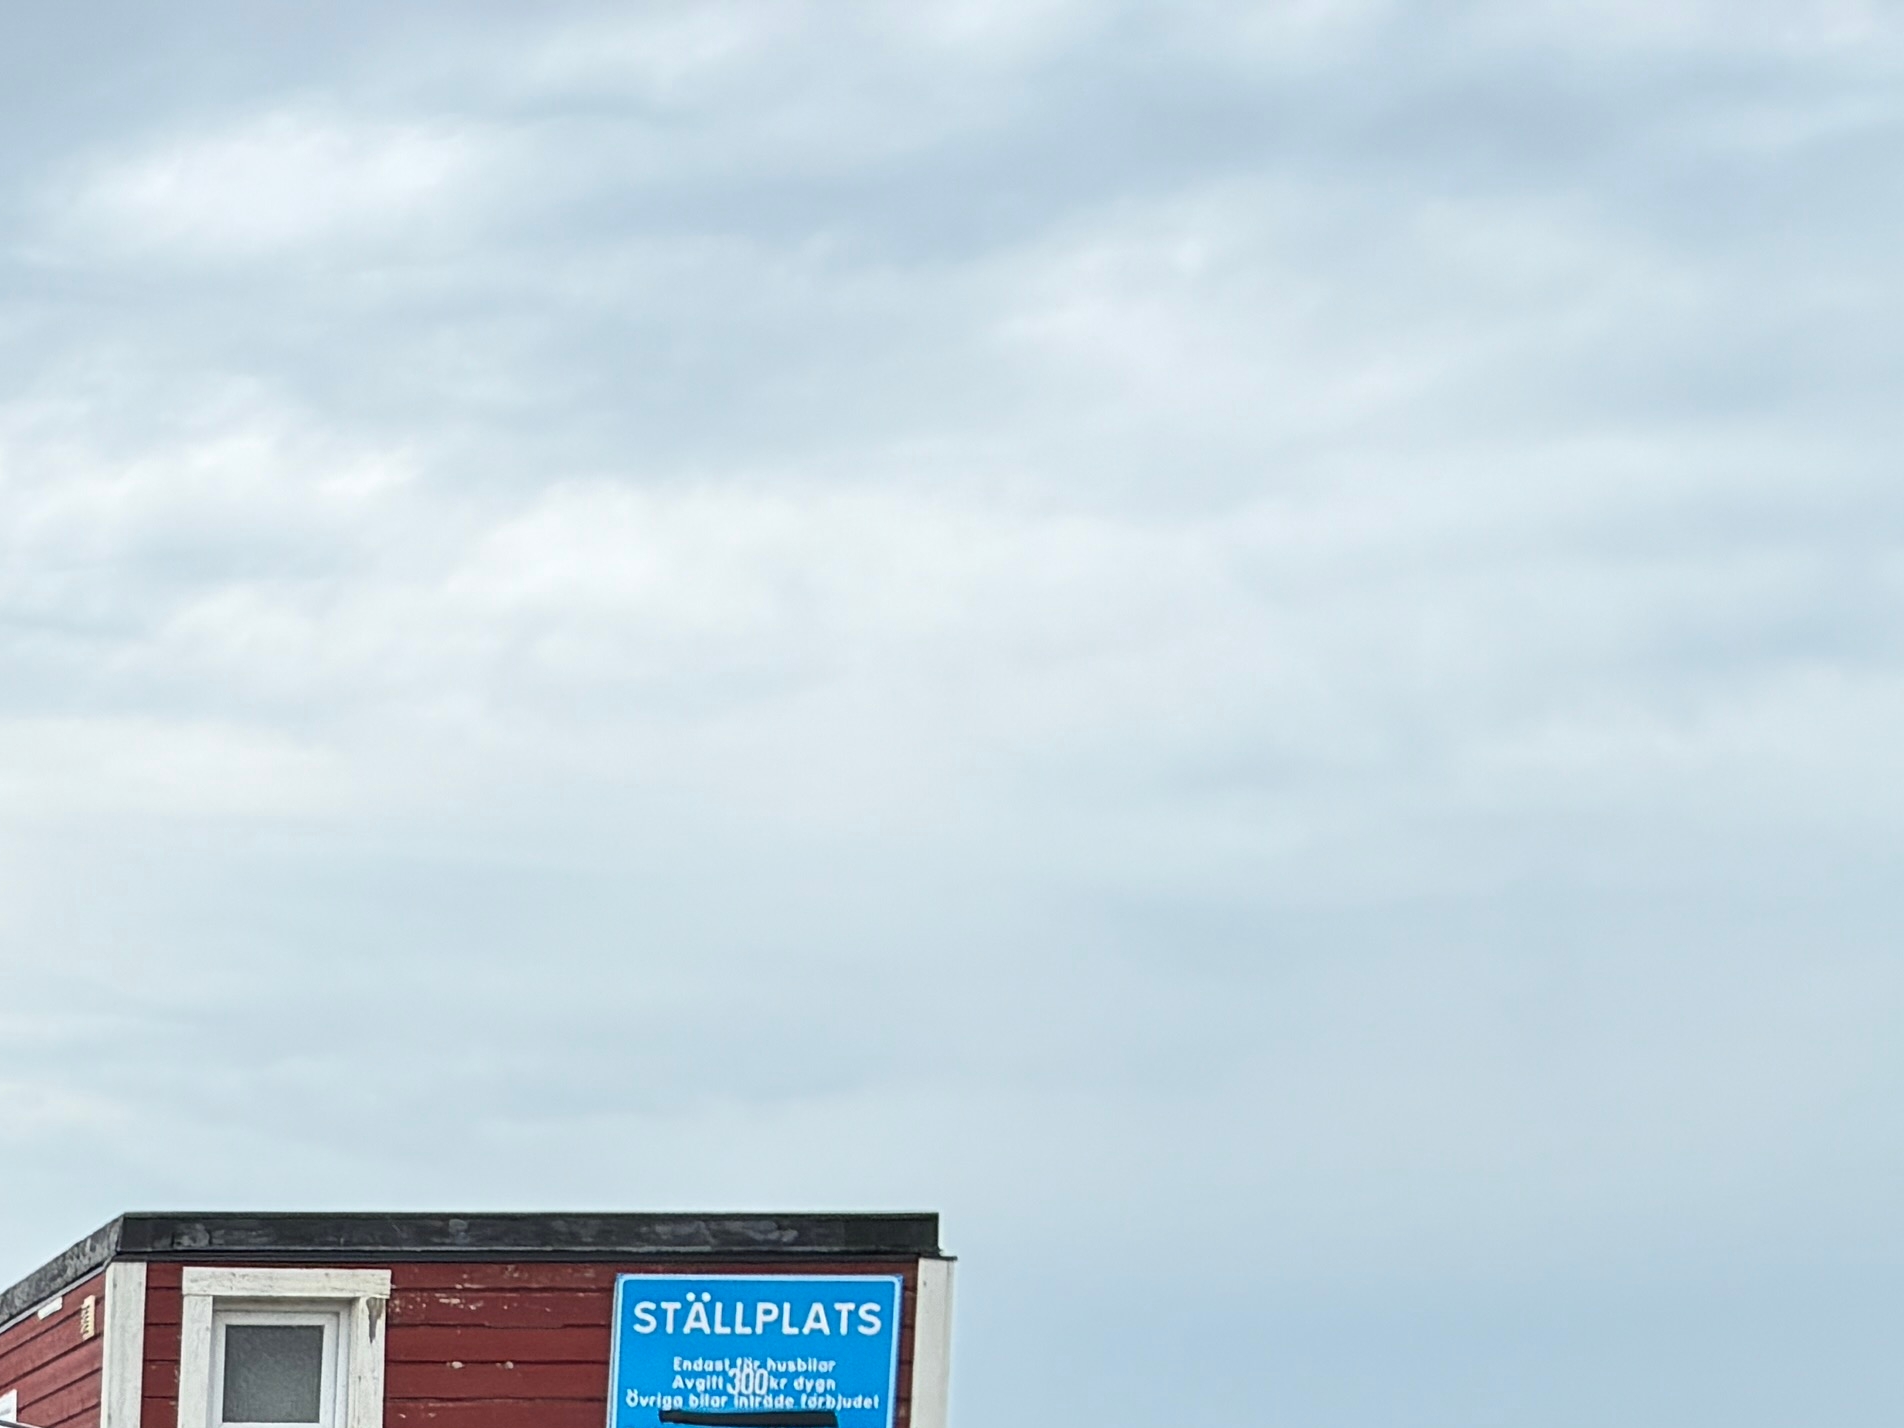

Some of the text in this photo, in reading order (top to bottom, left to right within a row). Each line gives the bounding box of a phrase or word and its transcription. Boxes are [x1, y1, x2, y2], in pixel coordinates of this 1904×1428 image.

[633, 1292, 882, 1336] STÄLLPLATS
[673, 1356, 730, 1372] Endast
[766, 1357, 837, 1373] husbilar
[672, 1368, 837, 1395] Avgift 300 kr dygn
[626, 1389, 880, 1411] Övriga bilar inträde förbjudet
